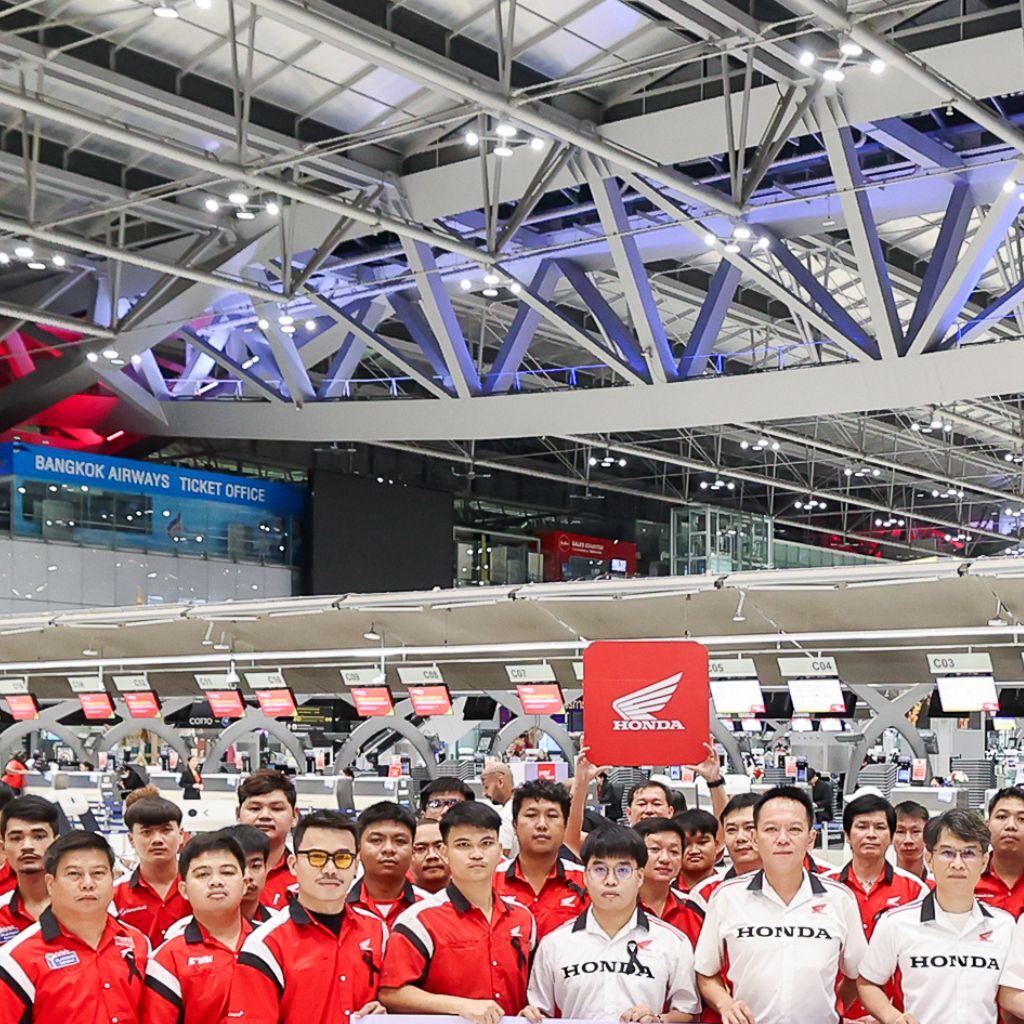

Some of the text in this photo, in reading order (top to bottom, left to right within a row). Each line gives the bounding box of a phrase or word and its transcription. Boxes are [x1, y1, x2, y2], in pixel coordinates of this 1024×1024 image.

[35, 454, 265, 502] BANGKOK AIRWAYS TICKET OFFICE
[811, 661, 832, 671] C04
[933, 658, 955, 668] C03
[612, 719, 685, 731] HONDA
[736, 926, 832, 940] HONDA
[909, 955, 1000, 970] HONDA
